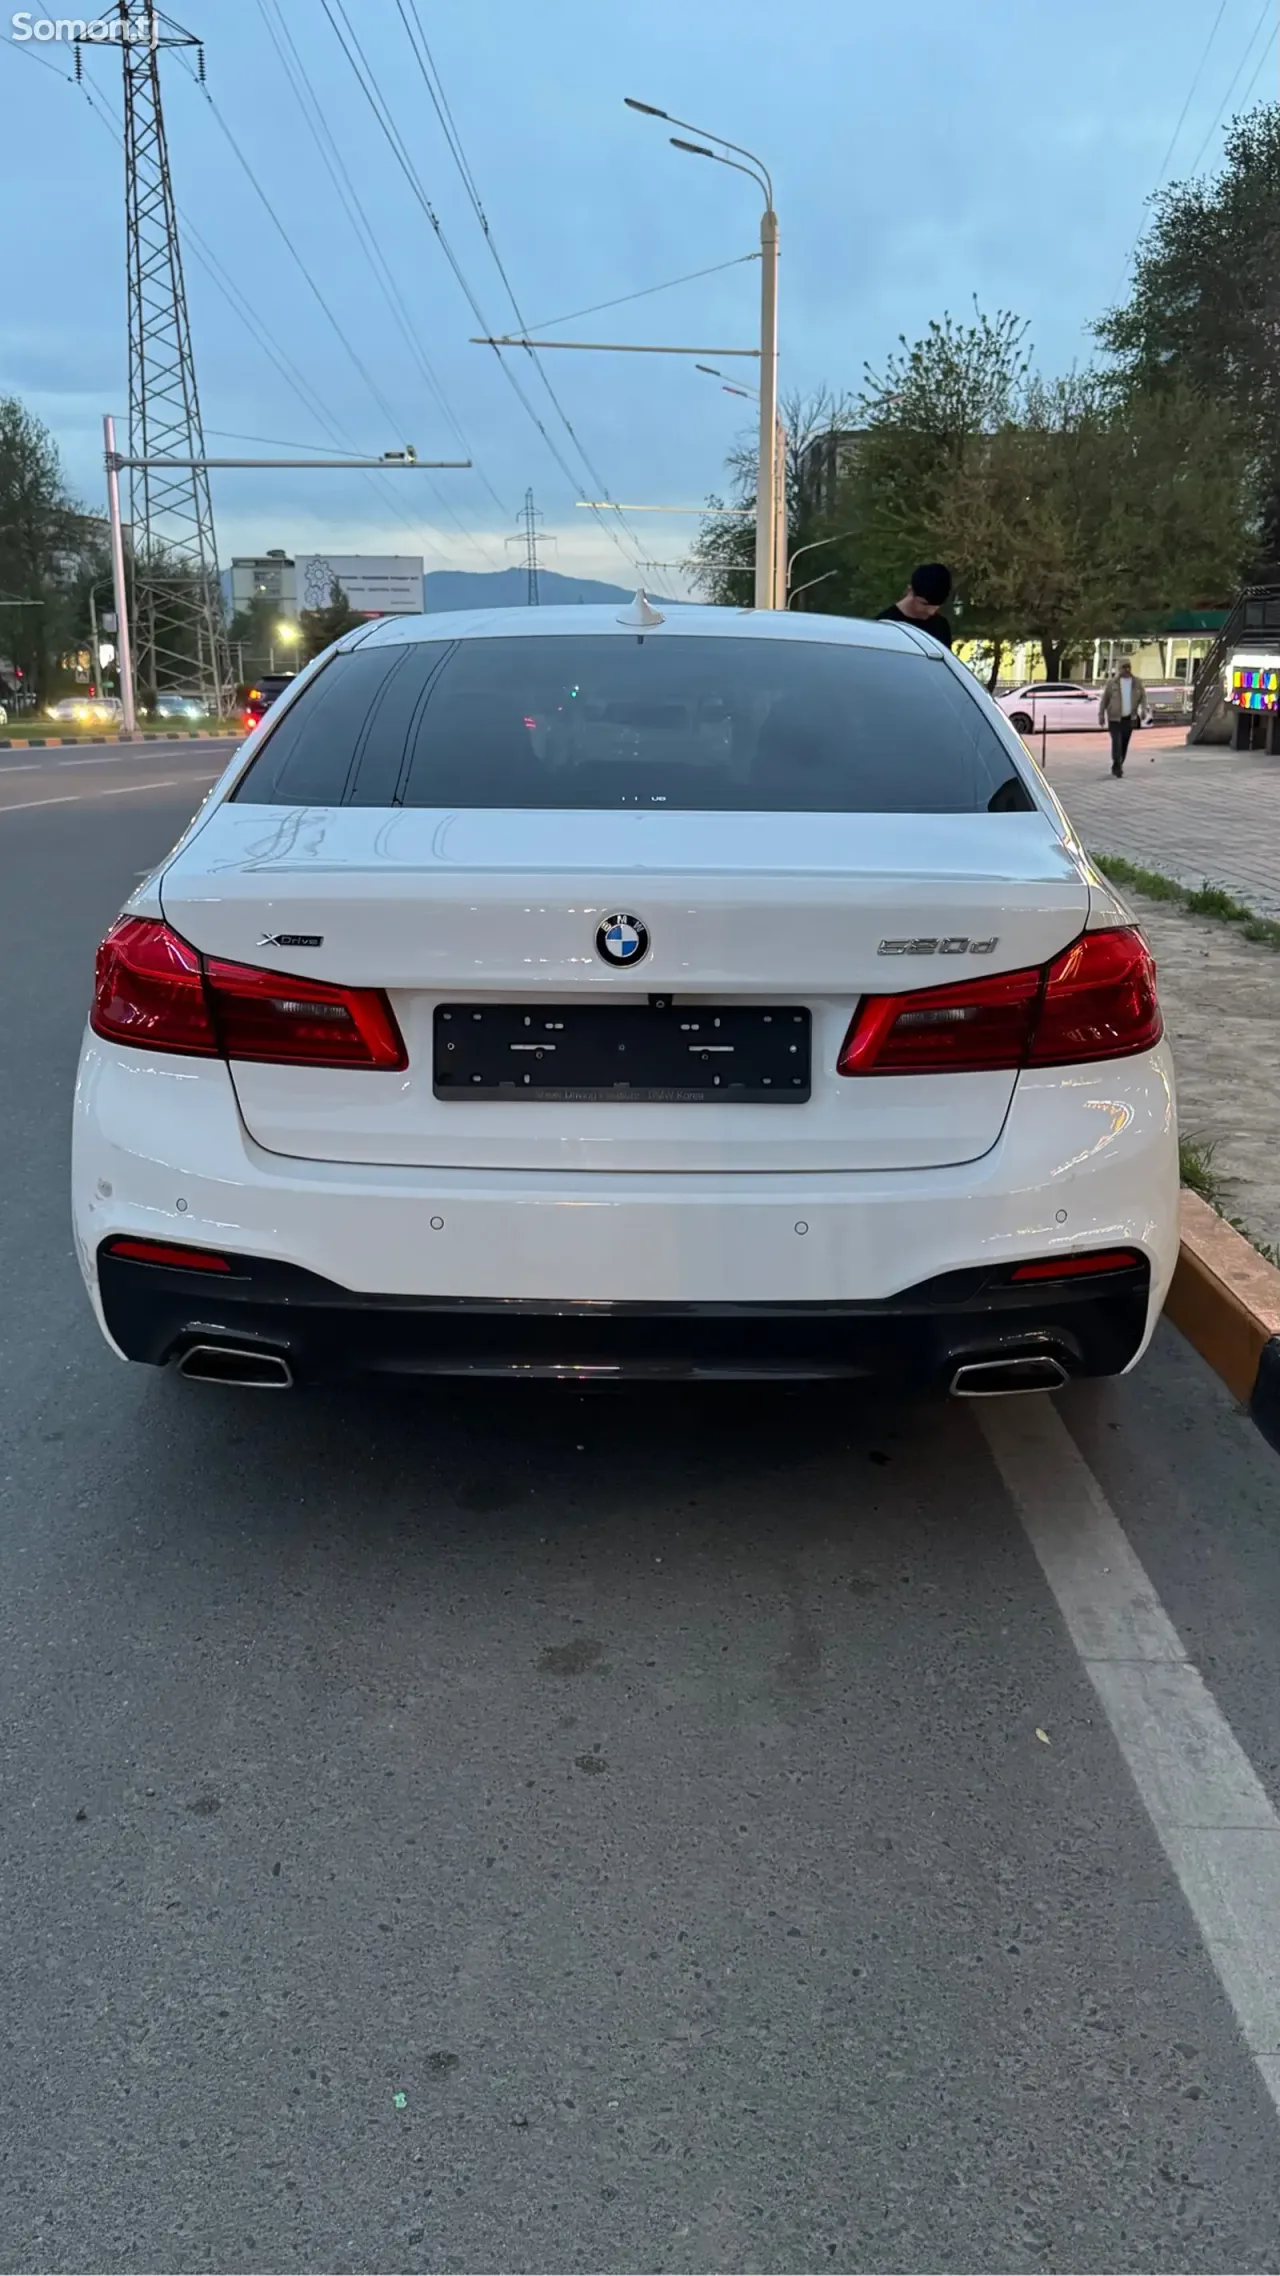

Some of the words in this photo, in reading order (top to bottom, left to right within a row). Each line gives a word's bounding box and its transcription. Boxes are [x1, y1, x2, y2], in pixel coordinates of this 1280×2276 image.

[601, 914, 645, 932] BMW
[877, 936, 999, 956] 520d
[676, 1090, 704, 1101] Korea
